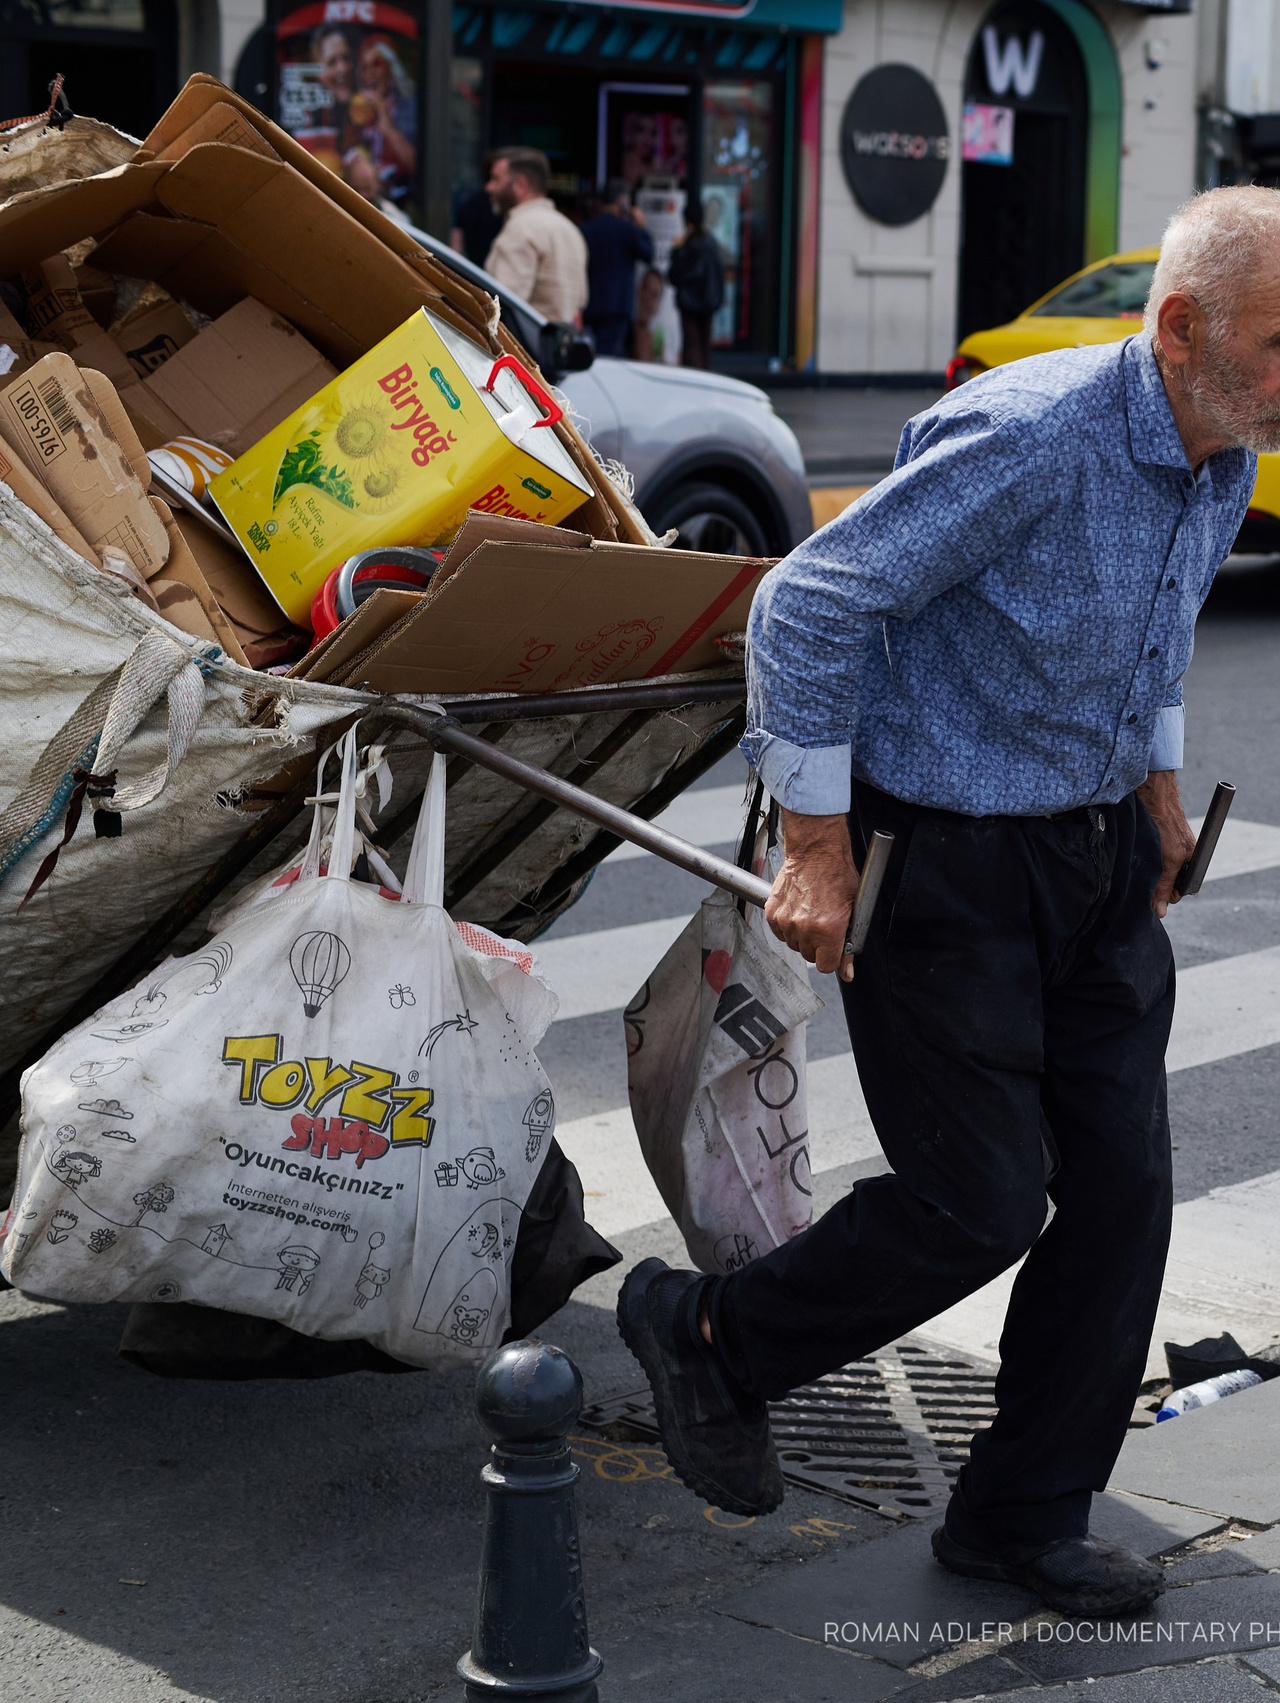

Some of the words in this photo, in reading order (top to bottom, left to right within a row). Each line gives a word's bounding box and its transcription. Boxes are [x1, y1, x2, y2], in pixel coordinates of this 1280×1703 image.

[981, 24, 1044, 99] W
[853, 129, 950, 160] watsos
[15, 391, 60, 457] 9765-001
[377, 362, 458, 467] Biryağ
[250, 521, 271, 552] TRAKYA
[288, 496, 312, 528] Ayçiçek
[310, 526, 325, 549] Yağı
[305, 497, 325, 526] Rafine
[222, 1033, 436, 1149] TOYZZ
[281, 1113, 390, 1170] SHOP
[222, 1192, 347, 1234] toyzzshop.com
